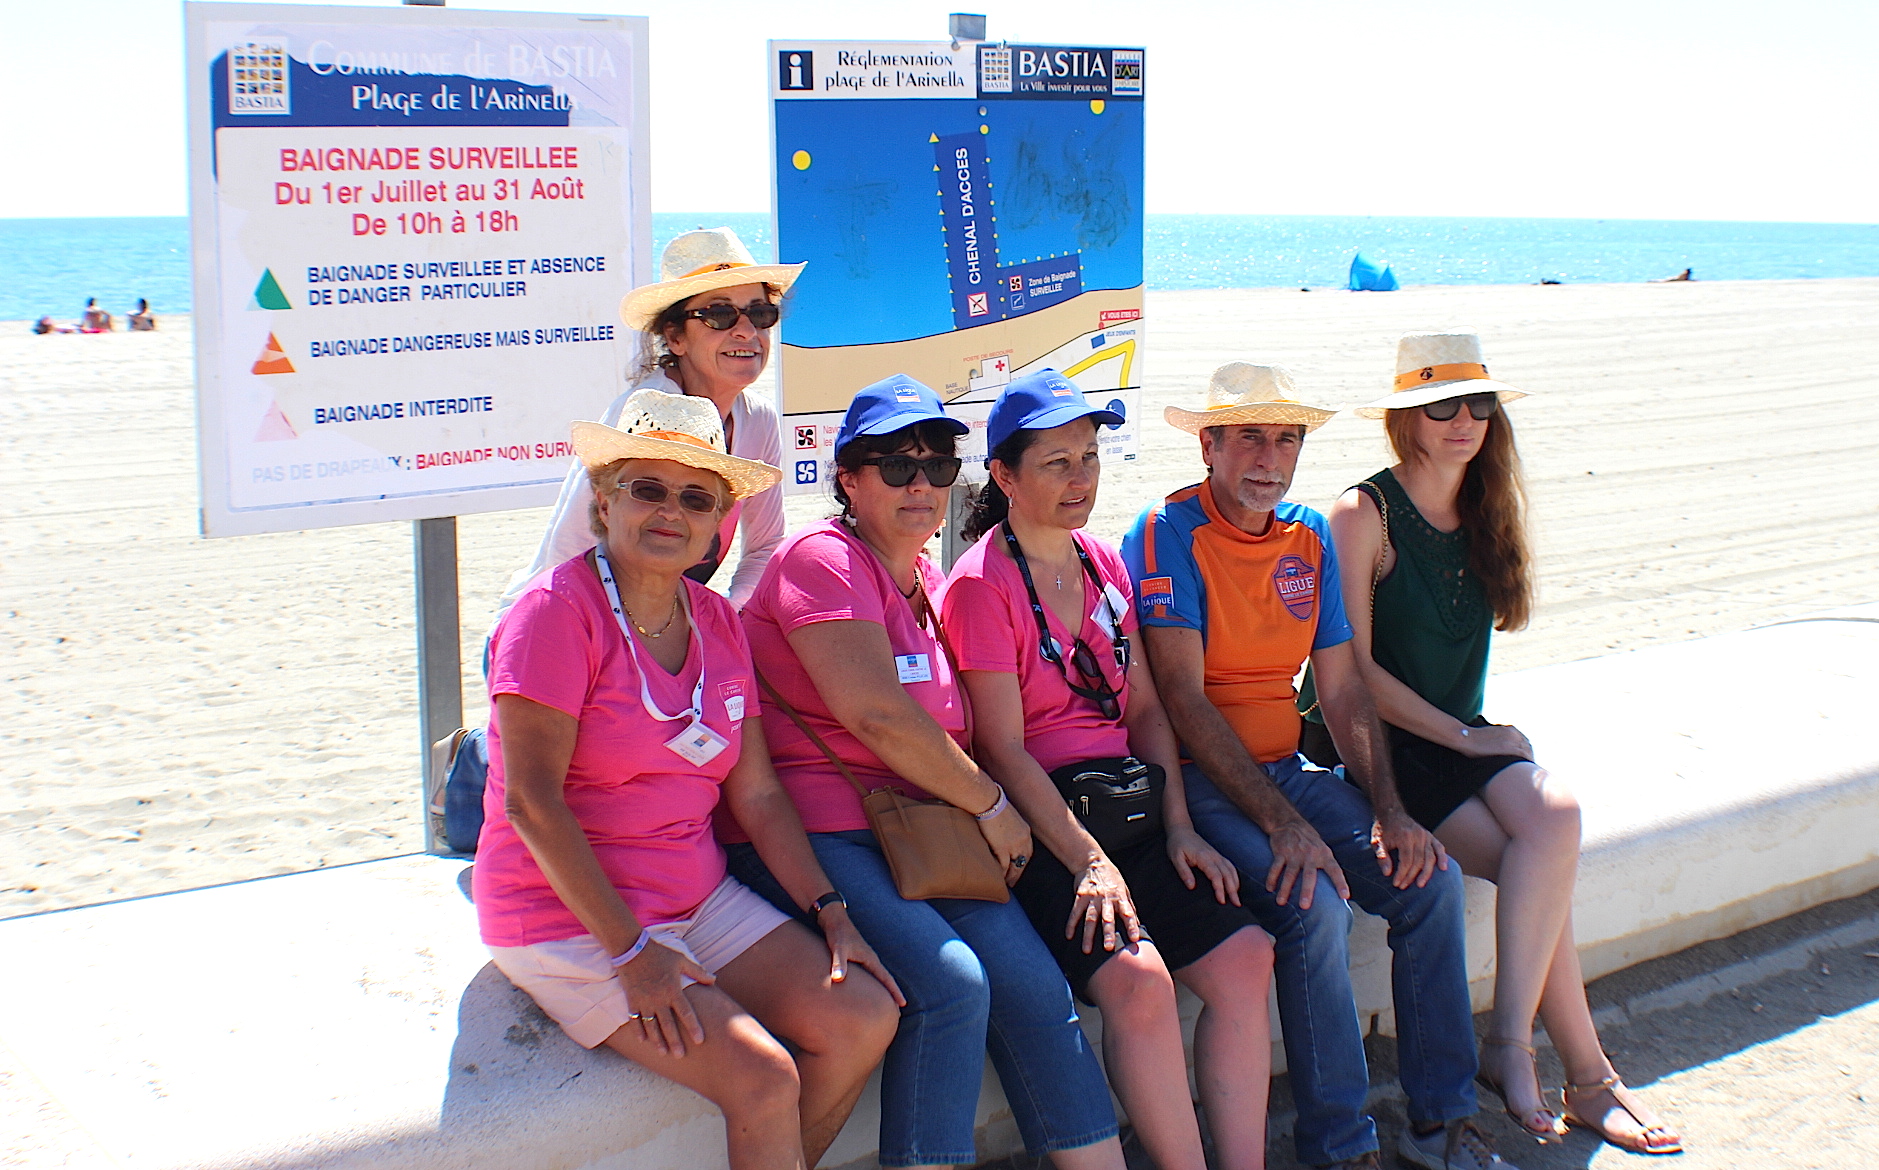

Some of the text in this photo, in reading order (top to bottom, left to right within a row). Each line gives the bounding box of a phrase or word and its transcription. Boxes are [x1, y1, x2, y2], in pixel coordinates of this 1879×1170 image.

[464, 40, 496, 76] de
[509, 44, 616, 77] BASTIA
[1019, 50, 1107, 77] BASTIA
[826, 71, 965, 91] plage de l'Arinella
[236, 96, 283, 108] BASTIA
[352, 83, 423, 116] Plage
[431, 84, 462, 110] de
[280, 146, 578, 171] BAIGNADE SURVEILLEE
[275, 176, 584, 205] Du 1er Juillet au 31 Août
[352, 210, 519, 236] De 10h à 18h
[955, 147, 981, 285] CHENAL D'ACCES
[307, 256, 605, 283] BAIGNADE SURVEILLEE ET ABSENCE
[1028, 270, 1076, 287] Zone de Baignade
[308, 281, 526, 306] DE DANGER PARTICULIER
[1029, 282, 1063, 297] SURVEILLEE
[310, 325, 614, 358] BAIGNADE DANGEREUSE MAIS SURVEILLEE
[946, 385, 968, 395] NAUTIQUE
[314, 396, 493, 424] BAIGNADE INTERDITE
[252, 465, 285, 483] PAS
[290, 463, 312, 480] DE
[416, 448, 492, 470] BAIGNADE
[497, 445, 530, 461] NON
[1278, 576, 1315, 594] LIGUE
